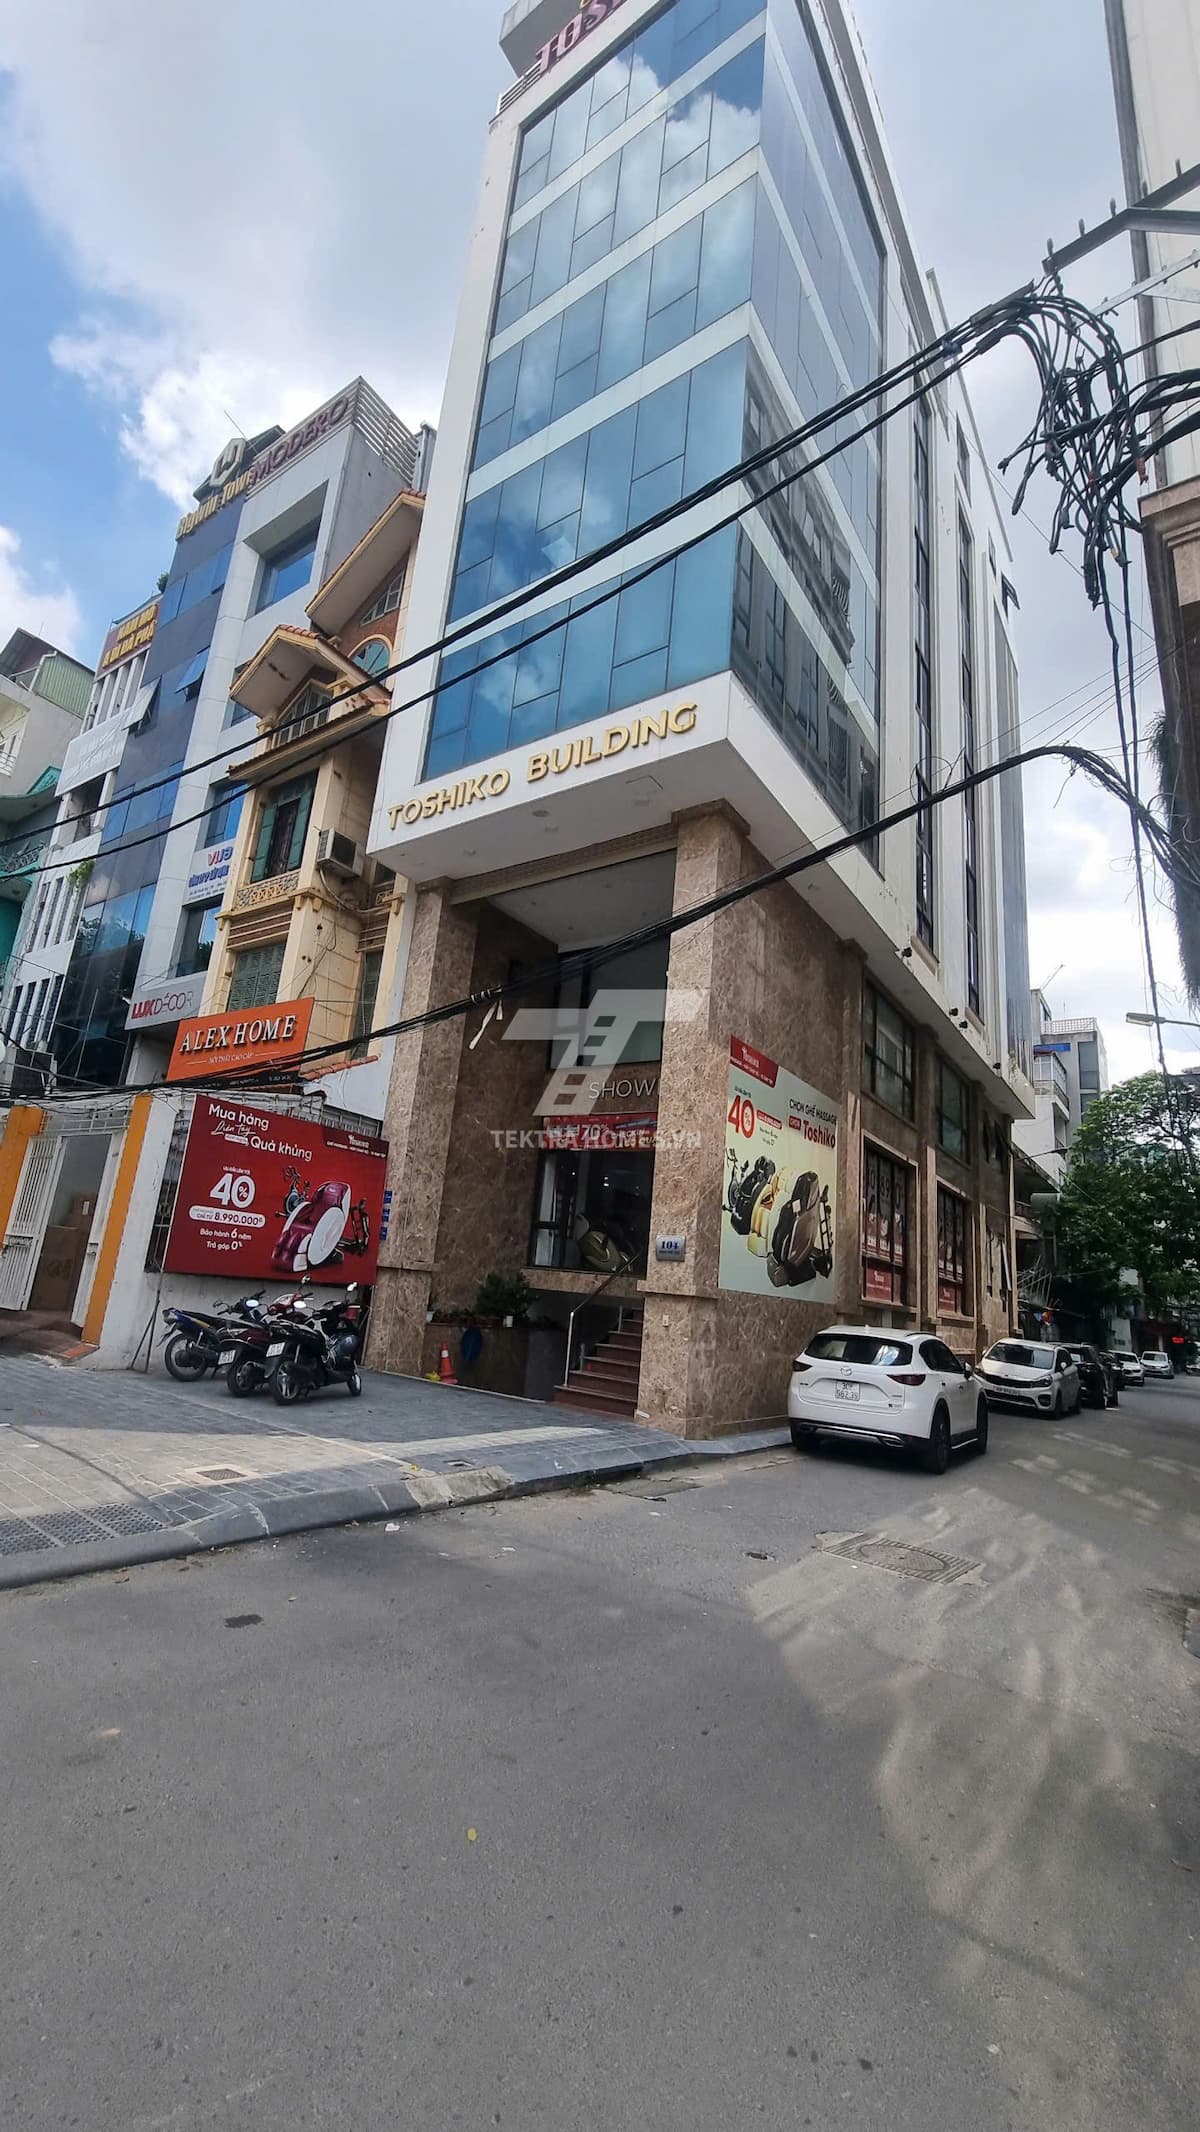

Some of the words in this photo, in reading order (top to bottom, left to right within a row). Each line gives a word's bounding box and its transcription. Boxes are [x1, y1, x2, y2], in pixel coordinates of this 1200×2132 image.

[536, 0, 627, 76] TOS
[387, 769, 511, 830] TOSHIKO
[526, 703, 698, 783] BUILDING
[179, 1025, 230, 1053] ALEX
[232, 1014, 297, 1046] HOME
[588, 1079, 660, 1099] SHOW
[208, 1103, 236, 1120] Mua
[239, 1111, 269, 1131] hàng
[803, 1119, 836, 1149] Toshiko
[250, 1136, 276, 1152] Quà
[278, 1141, 313, 1162] khủng
[230, 1228, 238, 1239] 6
